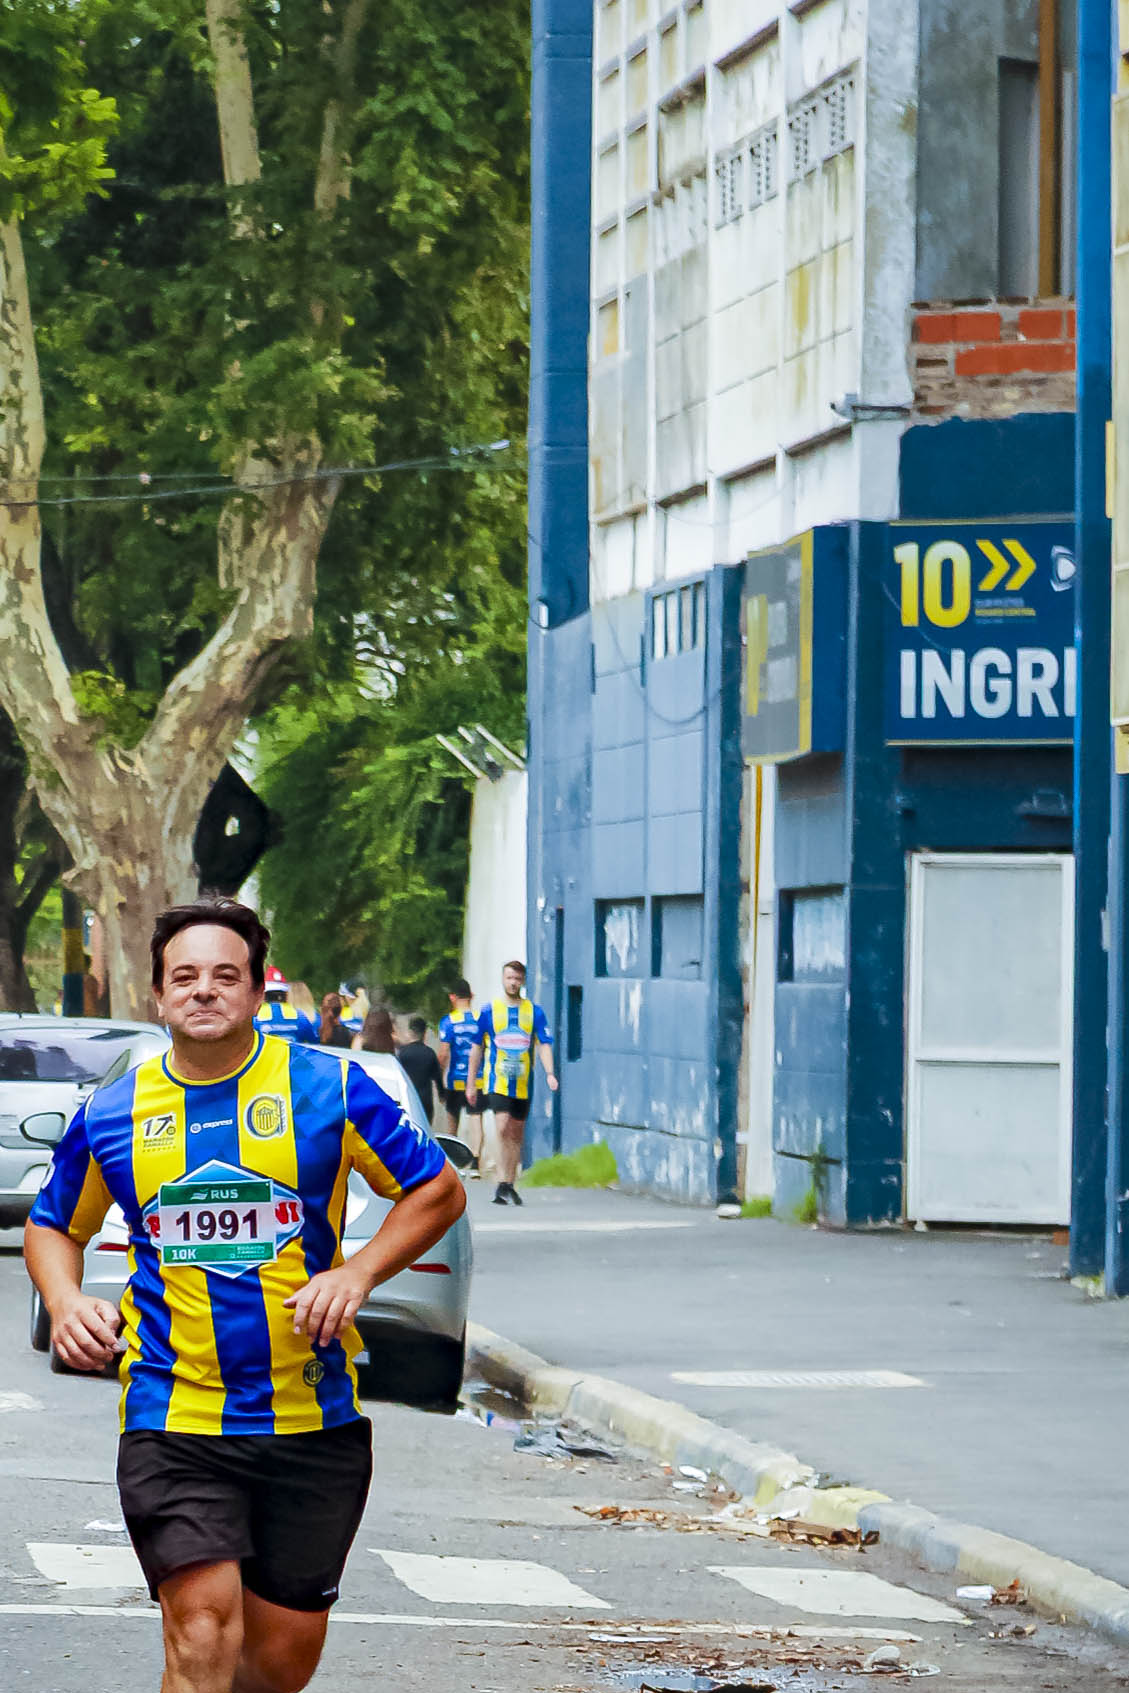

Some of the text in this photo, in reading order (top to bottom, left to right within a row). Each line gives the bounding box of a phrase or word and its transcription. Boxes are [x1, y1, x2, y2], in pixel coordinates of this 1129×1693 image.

[893, 540, 971, 628] 10
[210, 1188, 239, 1200] RUS
[176, 1208, 258, 1241] 1991
[172, 1248, 197, 1260] 10K
